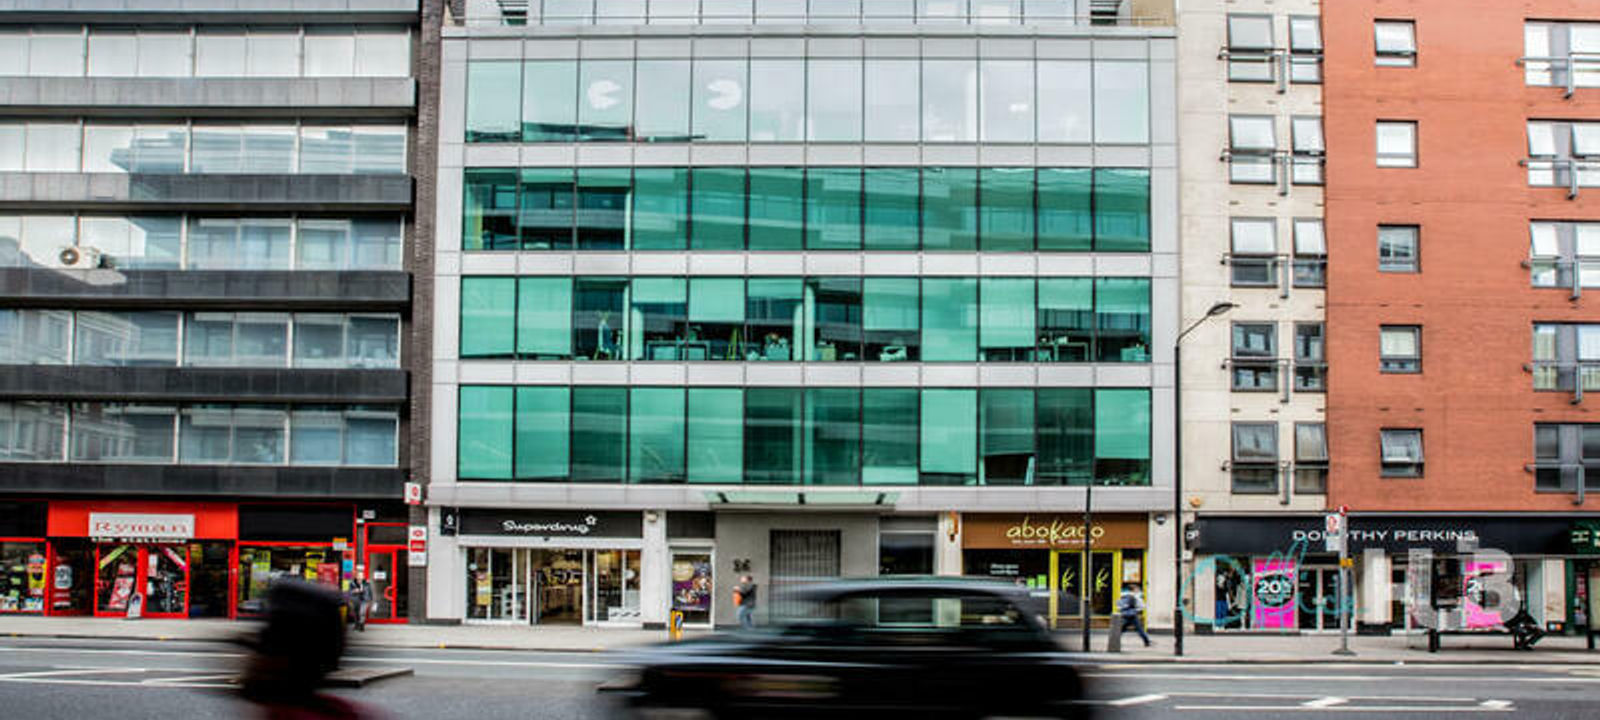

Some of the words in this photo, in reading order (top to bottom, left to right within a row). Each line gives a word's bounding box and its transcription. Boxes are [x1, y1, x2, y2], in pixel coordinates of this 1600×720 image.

[503, 520, 589, 534] Superdrug
[1292, 530, 1388, 541] DOTHY
[1393, 530, 1477, 542] PERKINS
